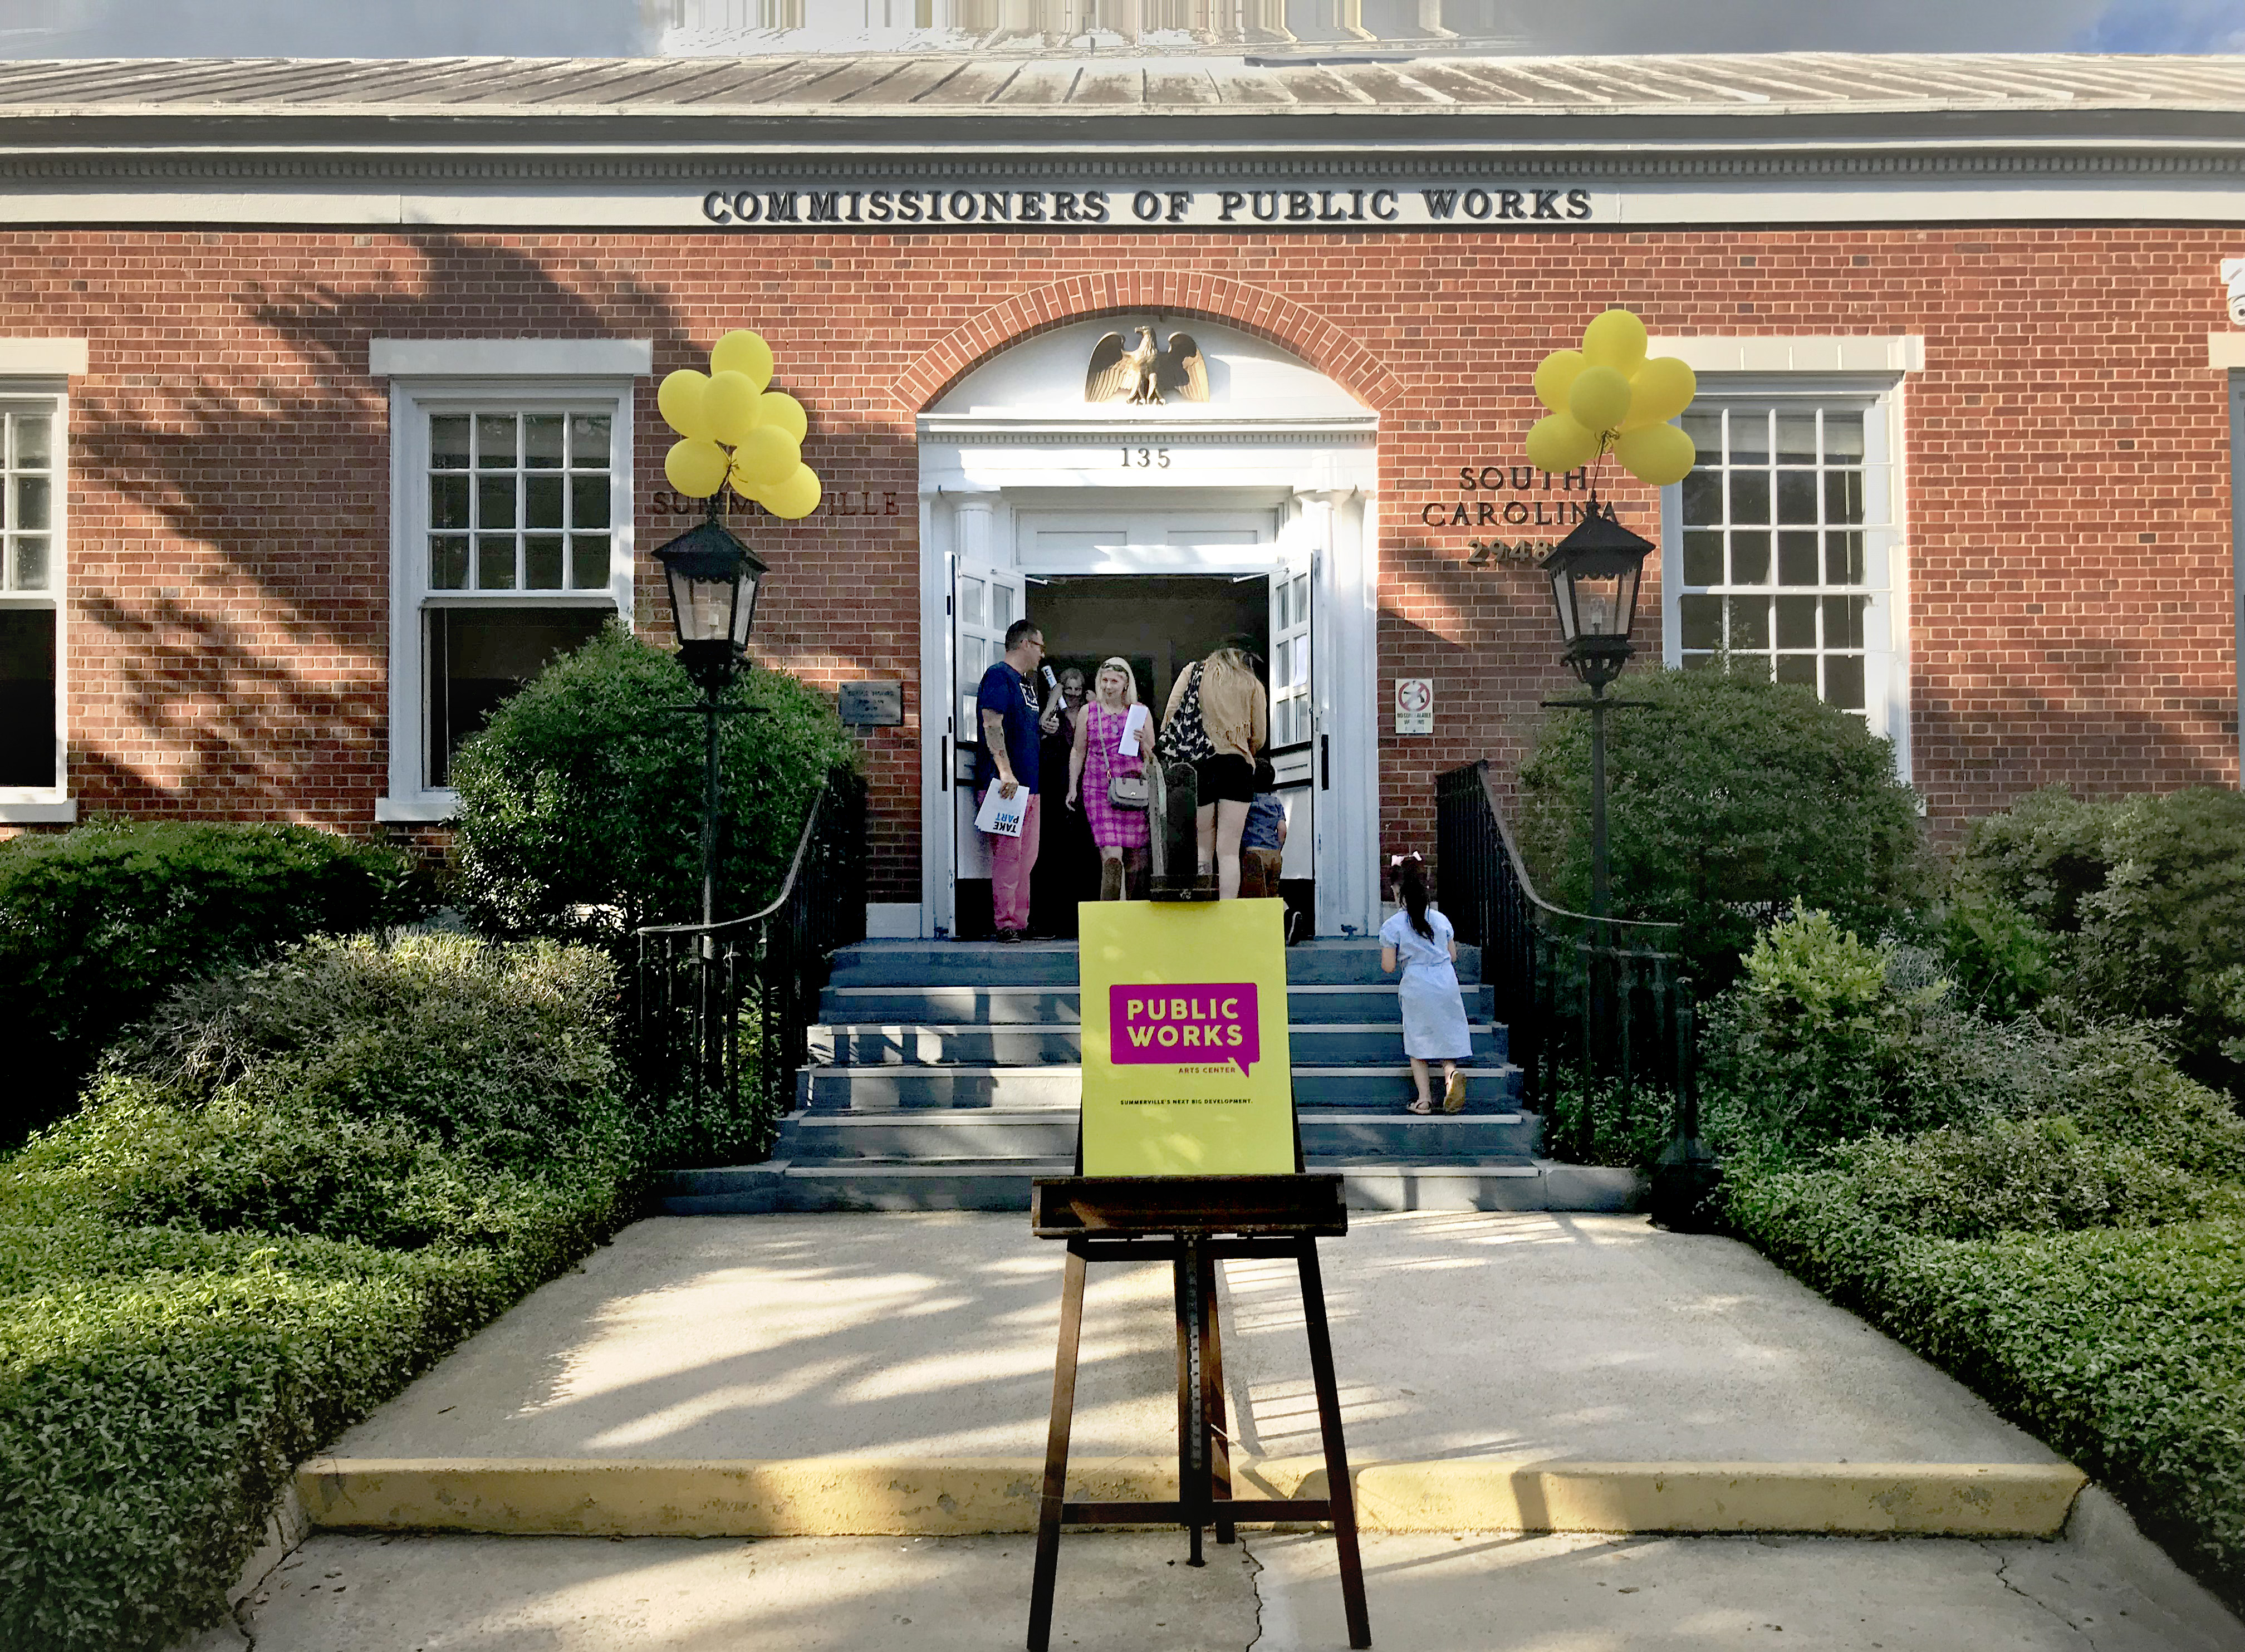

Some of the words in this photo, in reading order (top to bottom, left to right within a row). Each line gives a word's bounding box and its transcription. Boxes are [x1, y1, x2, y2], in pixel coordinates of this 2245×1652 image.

[702, 190, 1107, 222] COMMISSIONERS
[1131, 190, 1190, 221] OF
[1218, 189, 1396, 220] PUBLIC
[1419, 189, 1592, 220] WORKS
[1121, 447, 1171, 469] 135
[1459, 467, 1587, 491] SOUTH
[1421, 501, 1619, 527] CAROLINA
[1467, 539, 1561, 563] 2948
[993, 821, 1016, 833] TAKE
[996, 812, 1019, 824] PART
[1126, 998, 1239, 1021] PUBLIC
[1126, 1024, 1243, 1047] WORKS
